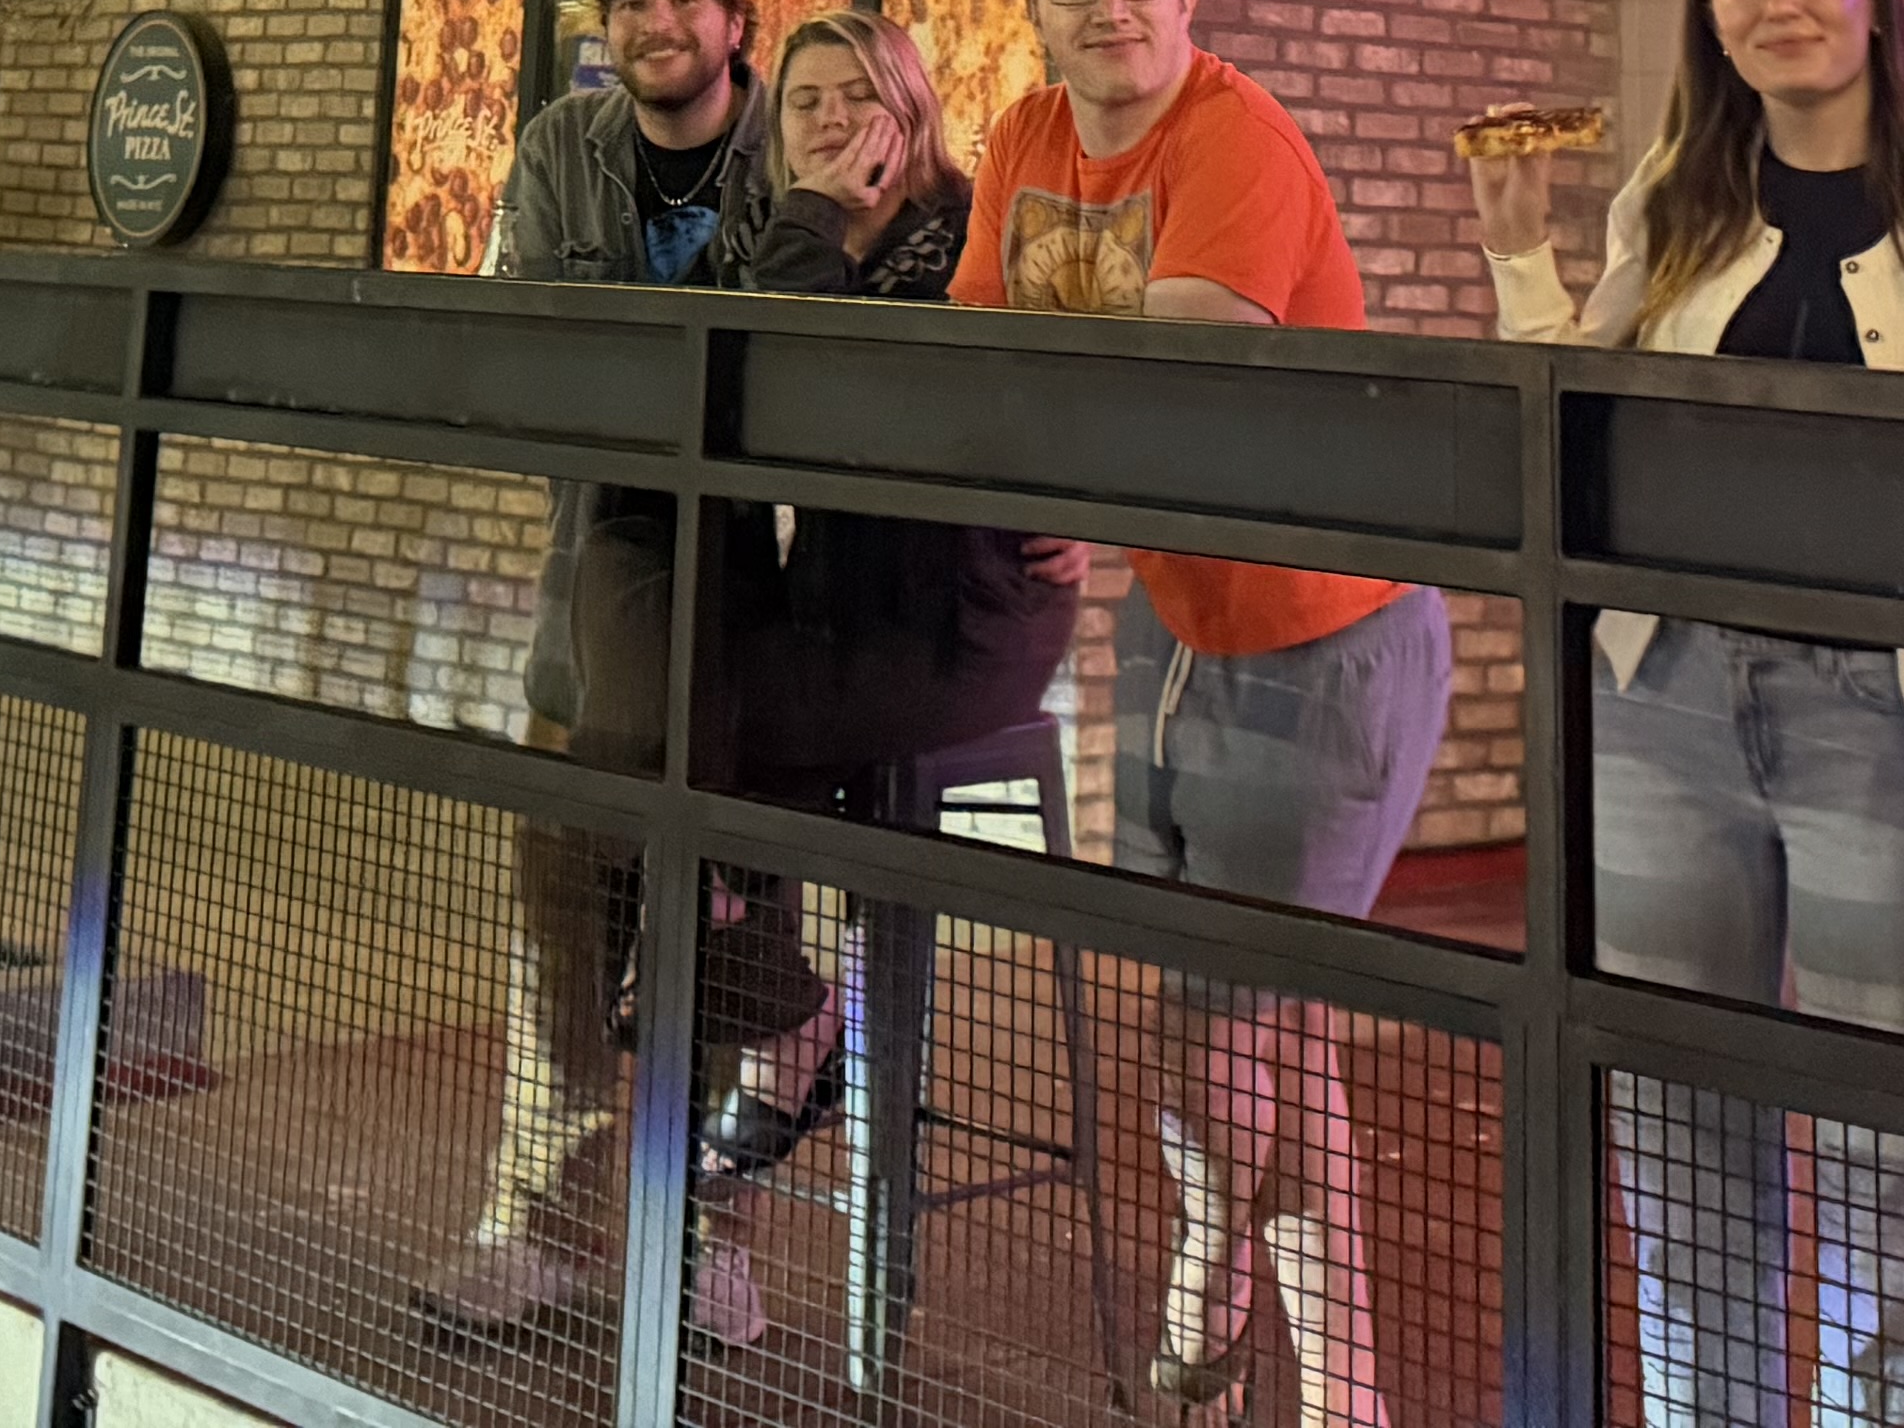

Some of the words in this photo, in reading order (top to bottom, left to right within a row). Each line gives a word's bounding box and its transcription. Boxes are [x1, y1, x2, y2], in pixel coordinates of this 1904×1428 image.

[105, 89, 169, 139] Prince
[167, 89, 197, 139] St.
[124, 136, 172, 160] PIZZA
